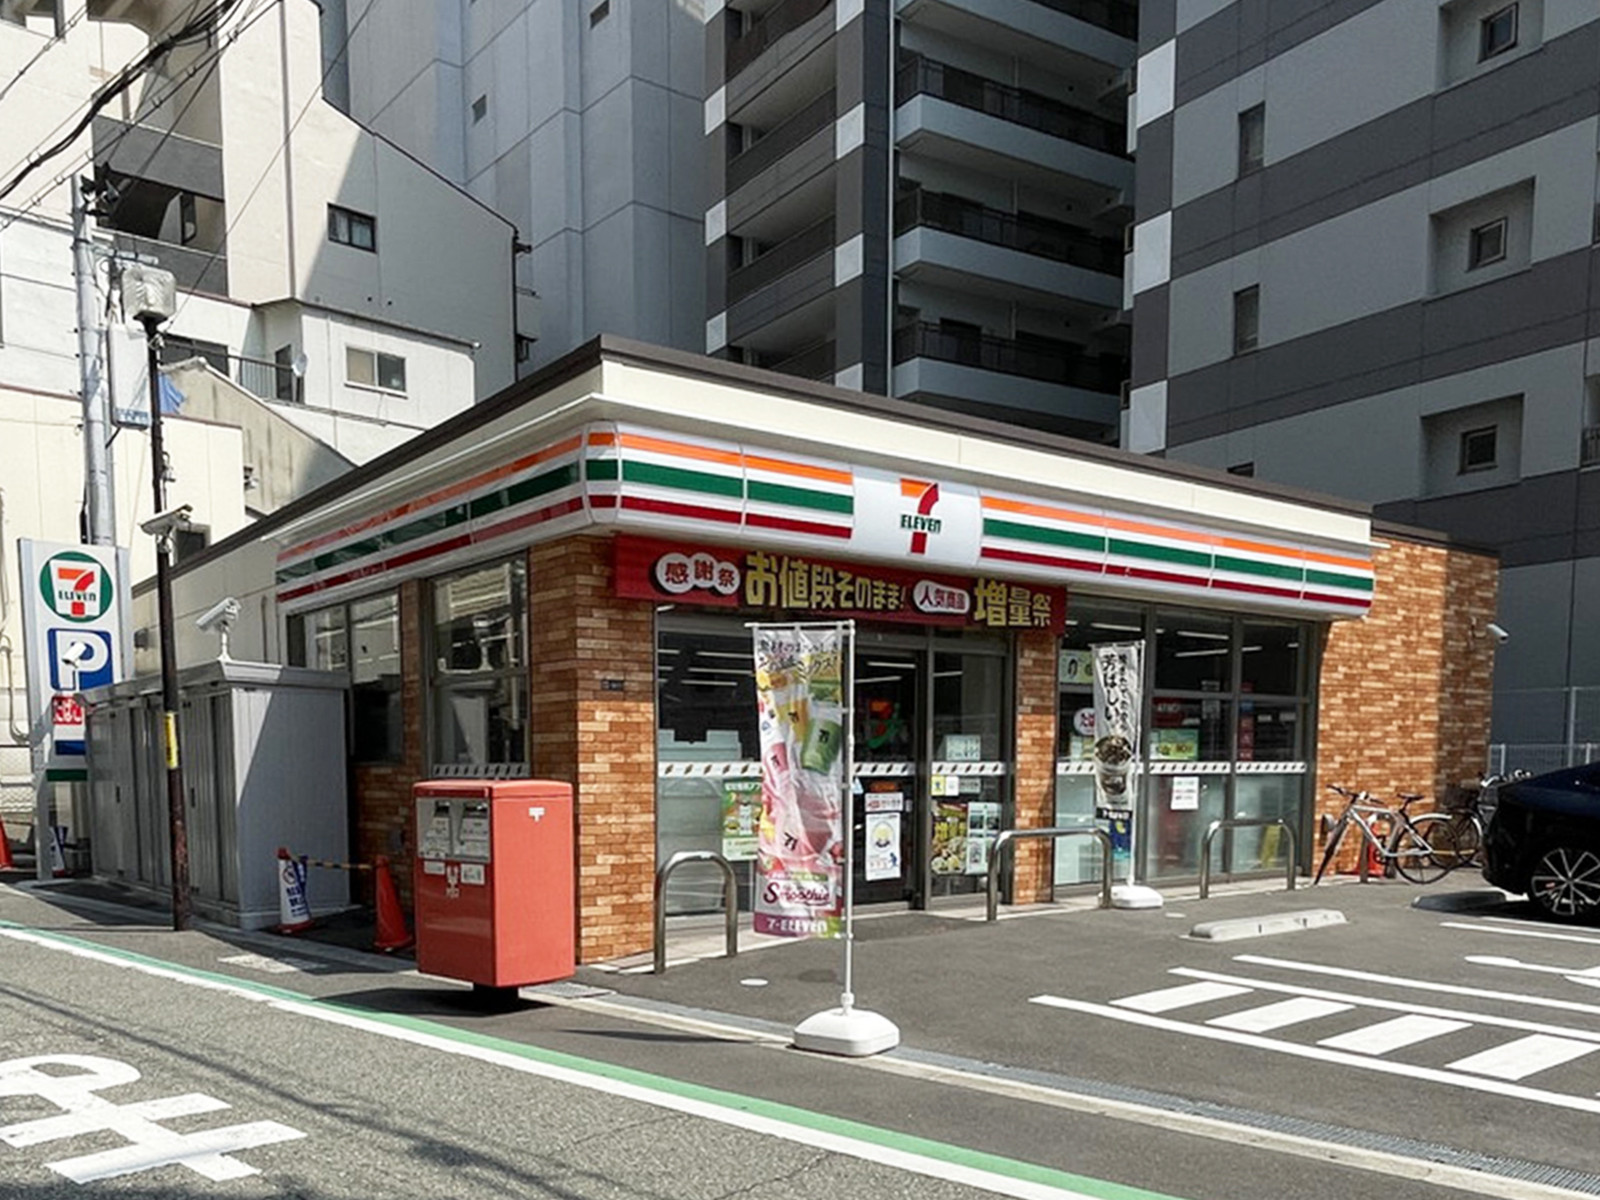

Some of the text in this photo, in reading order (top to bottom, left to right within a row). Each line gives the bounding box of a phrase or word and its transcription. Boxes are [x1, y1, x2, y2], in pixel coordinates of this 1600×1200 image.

[900, 478, 939, 555] 7
[58, 567, 95, 616] 7
[665, 559, 736, 588] 感謝祭
[974, 577, 1051, 627] 増量祭
[56, 630, 109, 691] P
